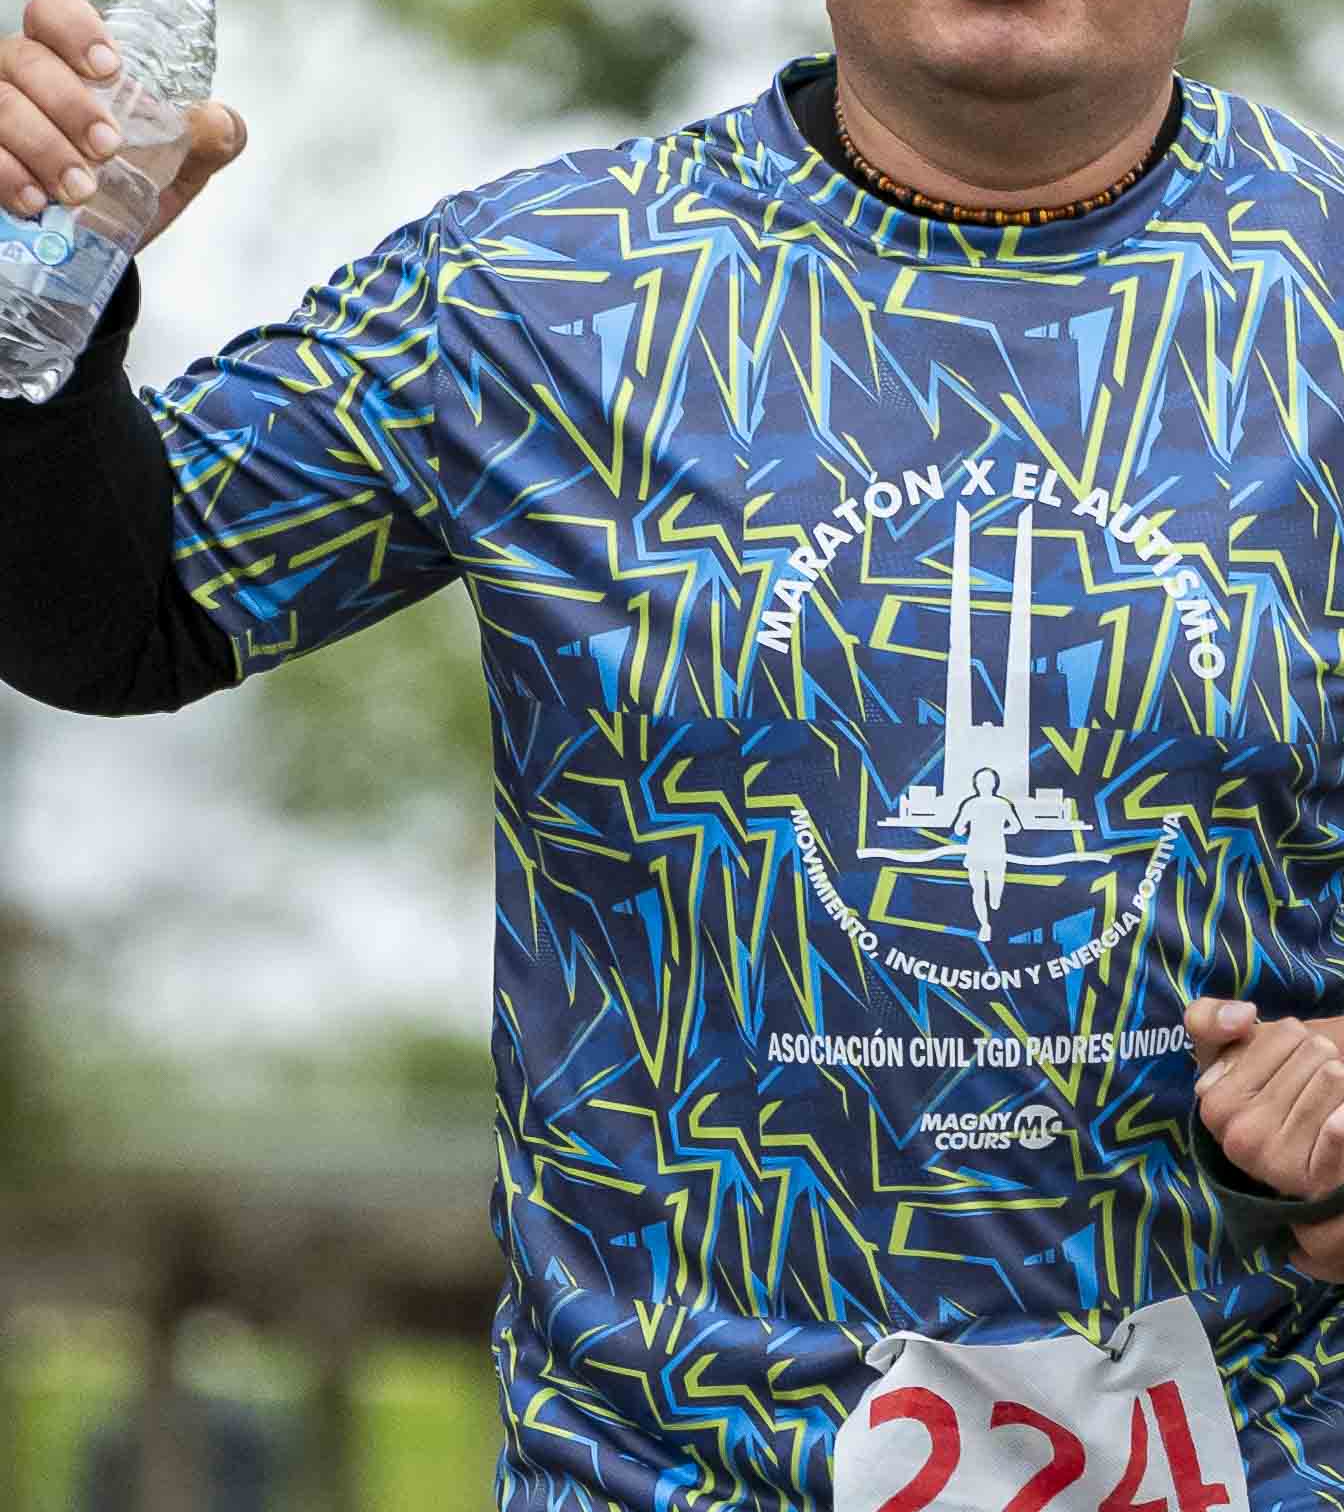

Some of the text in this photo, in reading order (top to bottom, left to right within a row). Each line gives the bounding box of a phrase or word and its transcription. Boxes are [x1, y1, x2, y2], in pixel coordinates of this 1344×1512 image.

[756, 459, 1226, 680] MARATÓN X EL AUTISMO
[790, 808, 1184, 991] MOVIMIENTO, INCLUSIÓN Y ENERGÍA POSITIVA
[768, 1028, 904, 1068] ASOCIACIÓN
[909, 1036, 970, 1068] CIVIL
[972, 1038, 1021, 1068] TGD
[1025, 1032, 1115, 1067] PADRES
[919, 1112, 1012, 1132] MAGNY
[934, 1131, 1011, 1150] COURS
